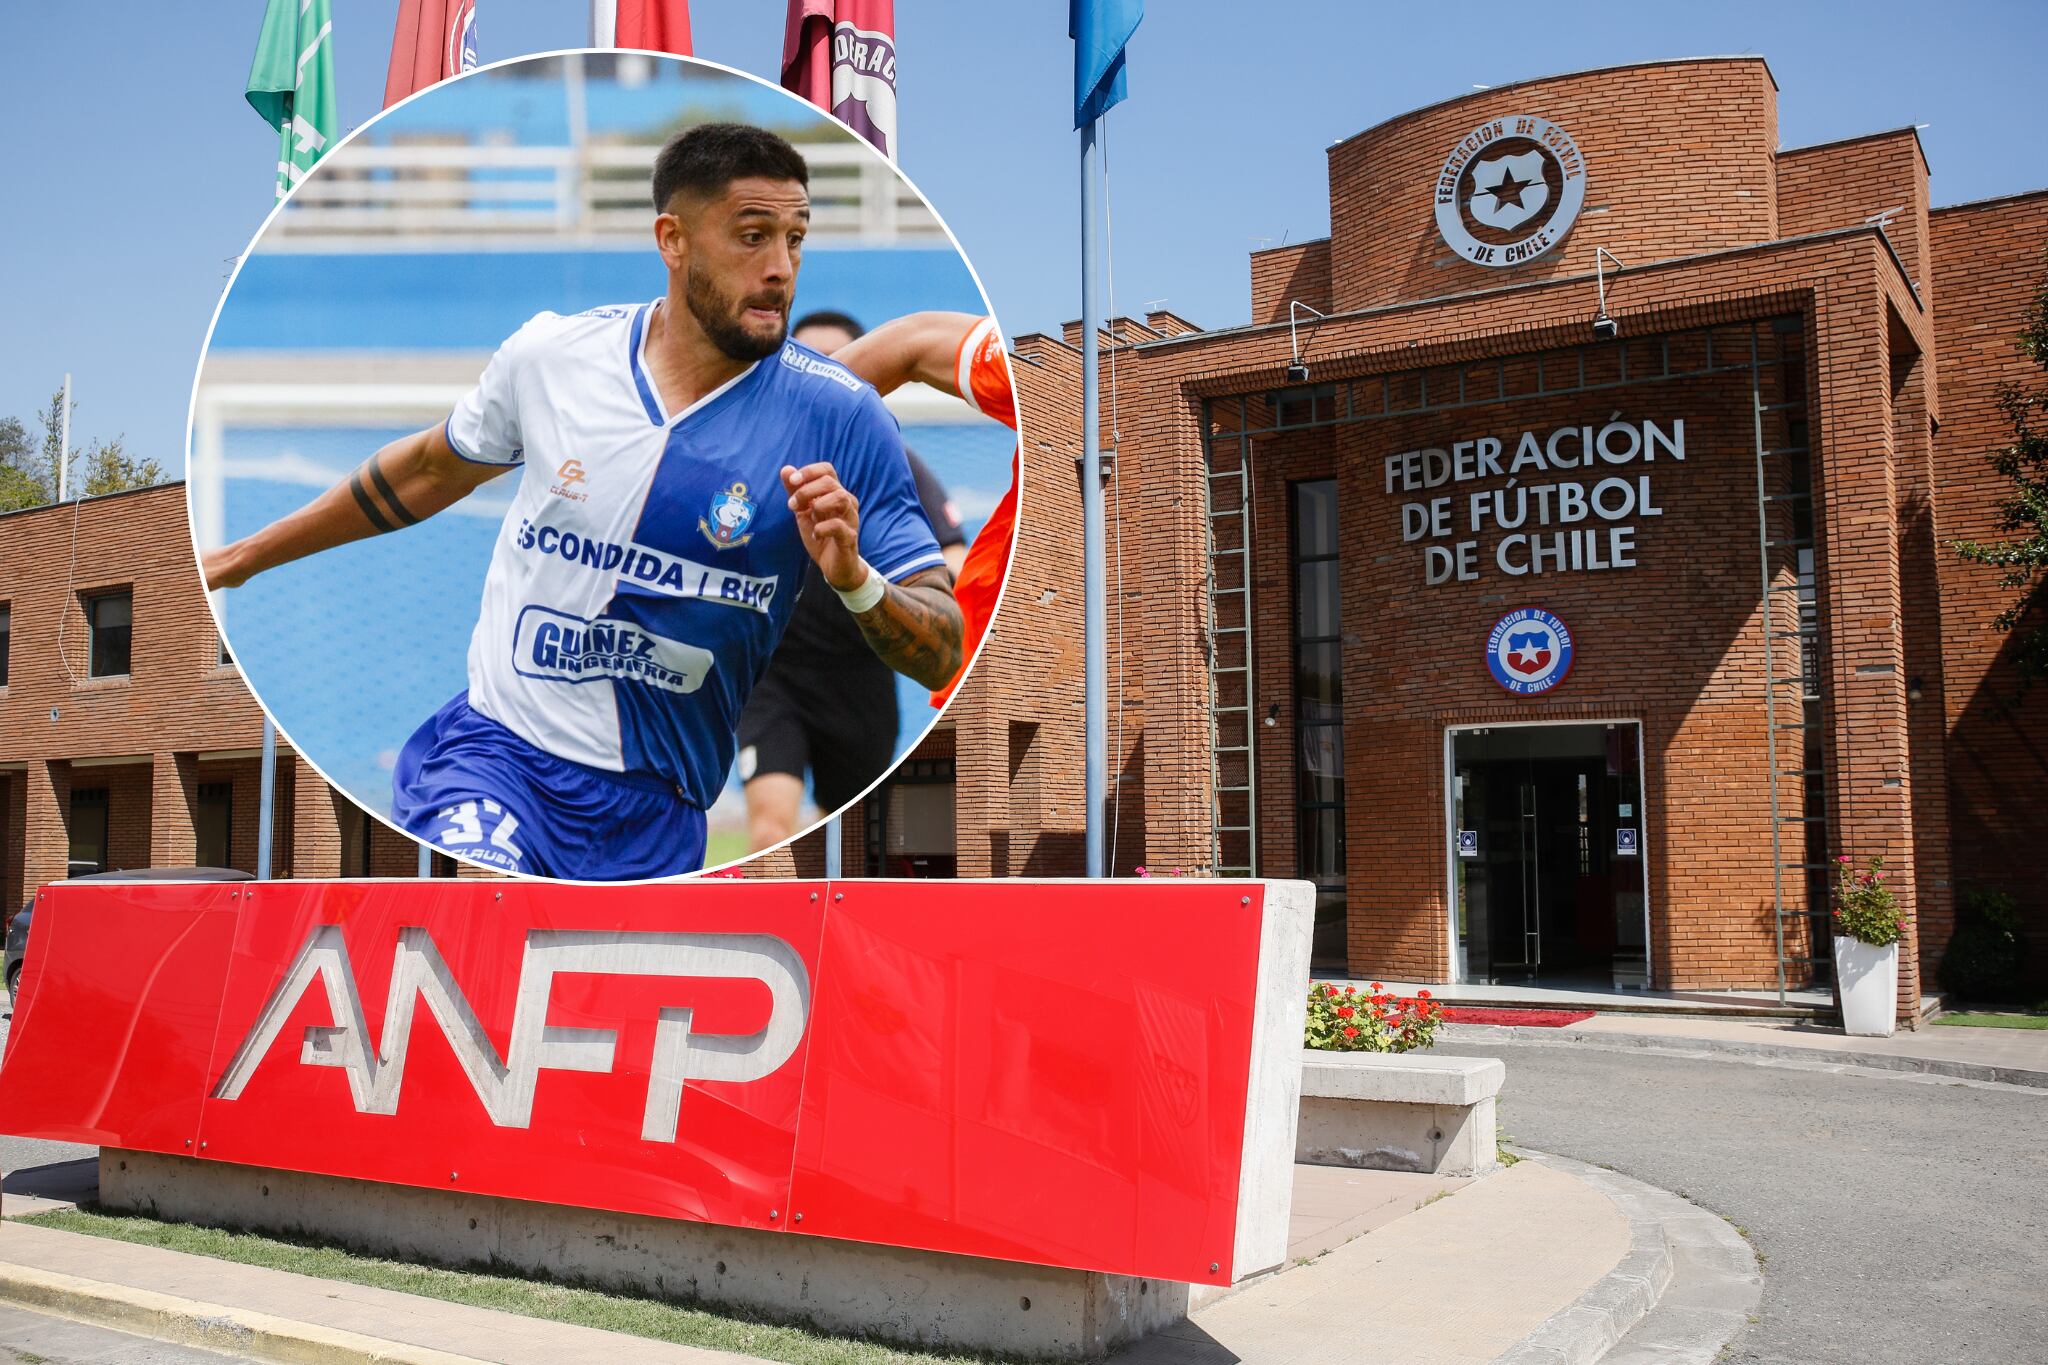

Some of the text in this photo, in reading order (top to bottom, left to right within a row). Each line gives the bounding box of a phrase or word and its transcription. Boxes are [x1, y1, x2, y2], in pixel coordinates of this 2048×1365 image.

[1437, 121, 1504, 205] FEDERACION
[1515, 117, 1537, 134] DE
[1473, 232, 1551, 263] DE CHILE
[1385, 410, 1686, 494] FEDERACIÓN
[1402, 477, 1663, 542] DE FÚTBOL
[1425, 527, 1637, 586] DE CHILE
[720, 576, 775, 608] BHP
[1488, 609, 1571, 654] FEDERACION DE FUTBOL
[1509, 676, 1555, 693] DE CHILE
[209, 924, 811, 1143] ANFP
